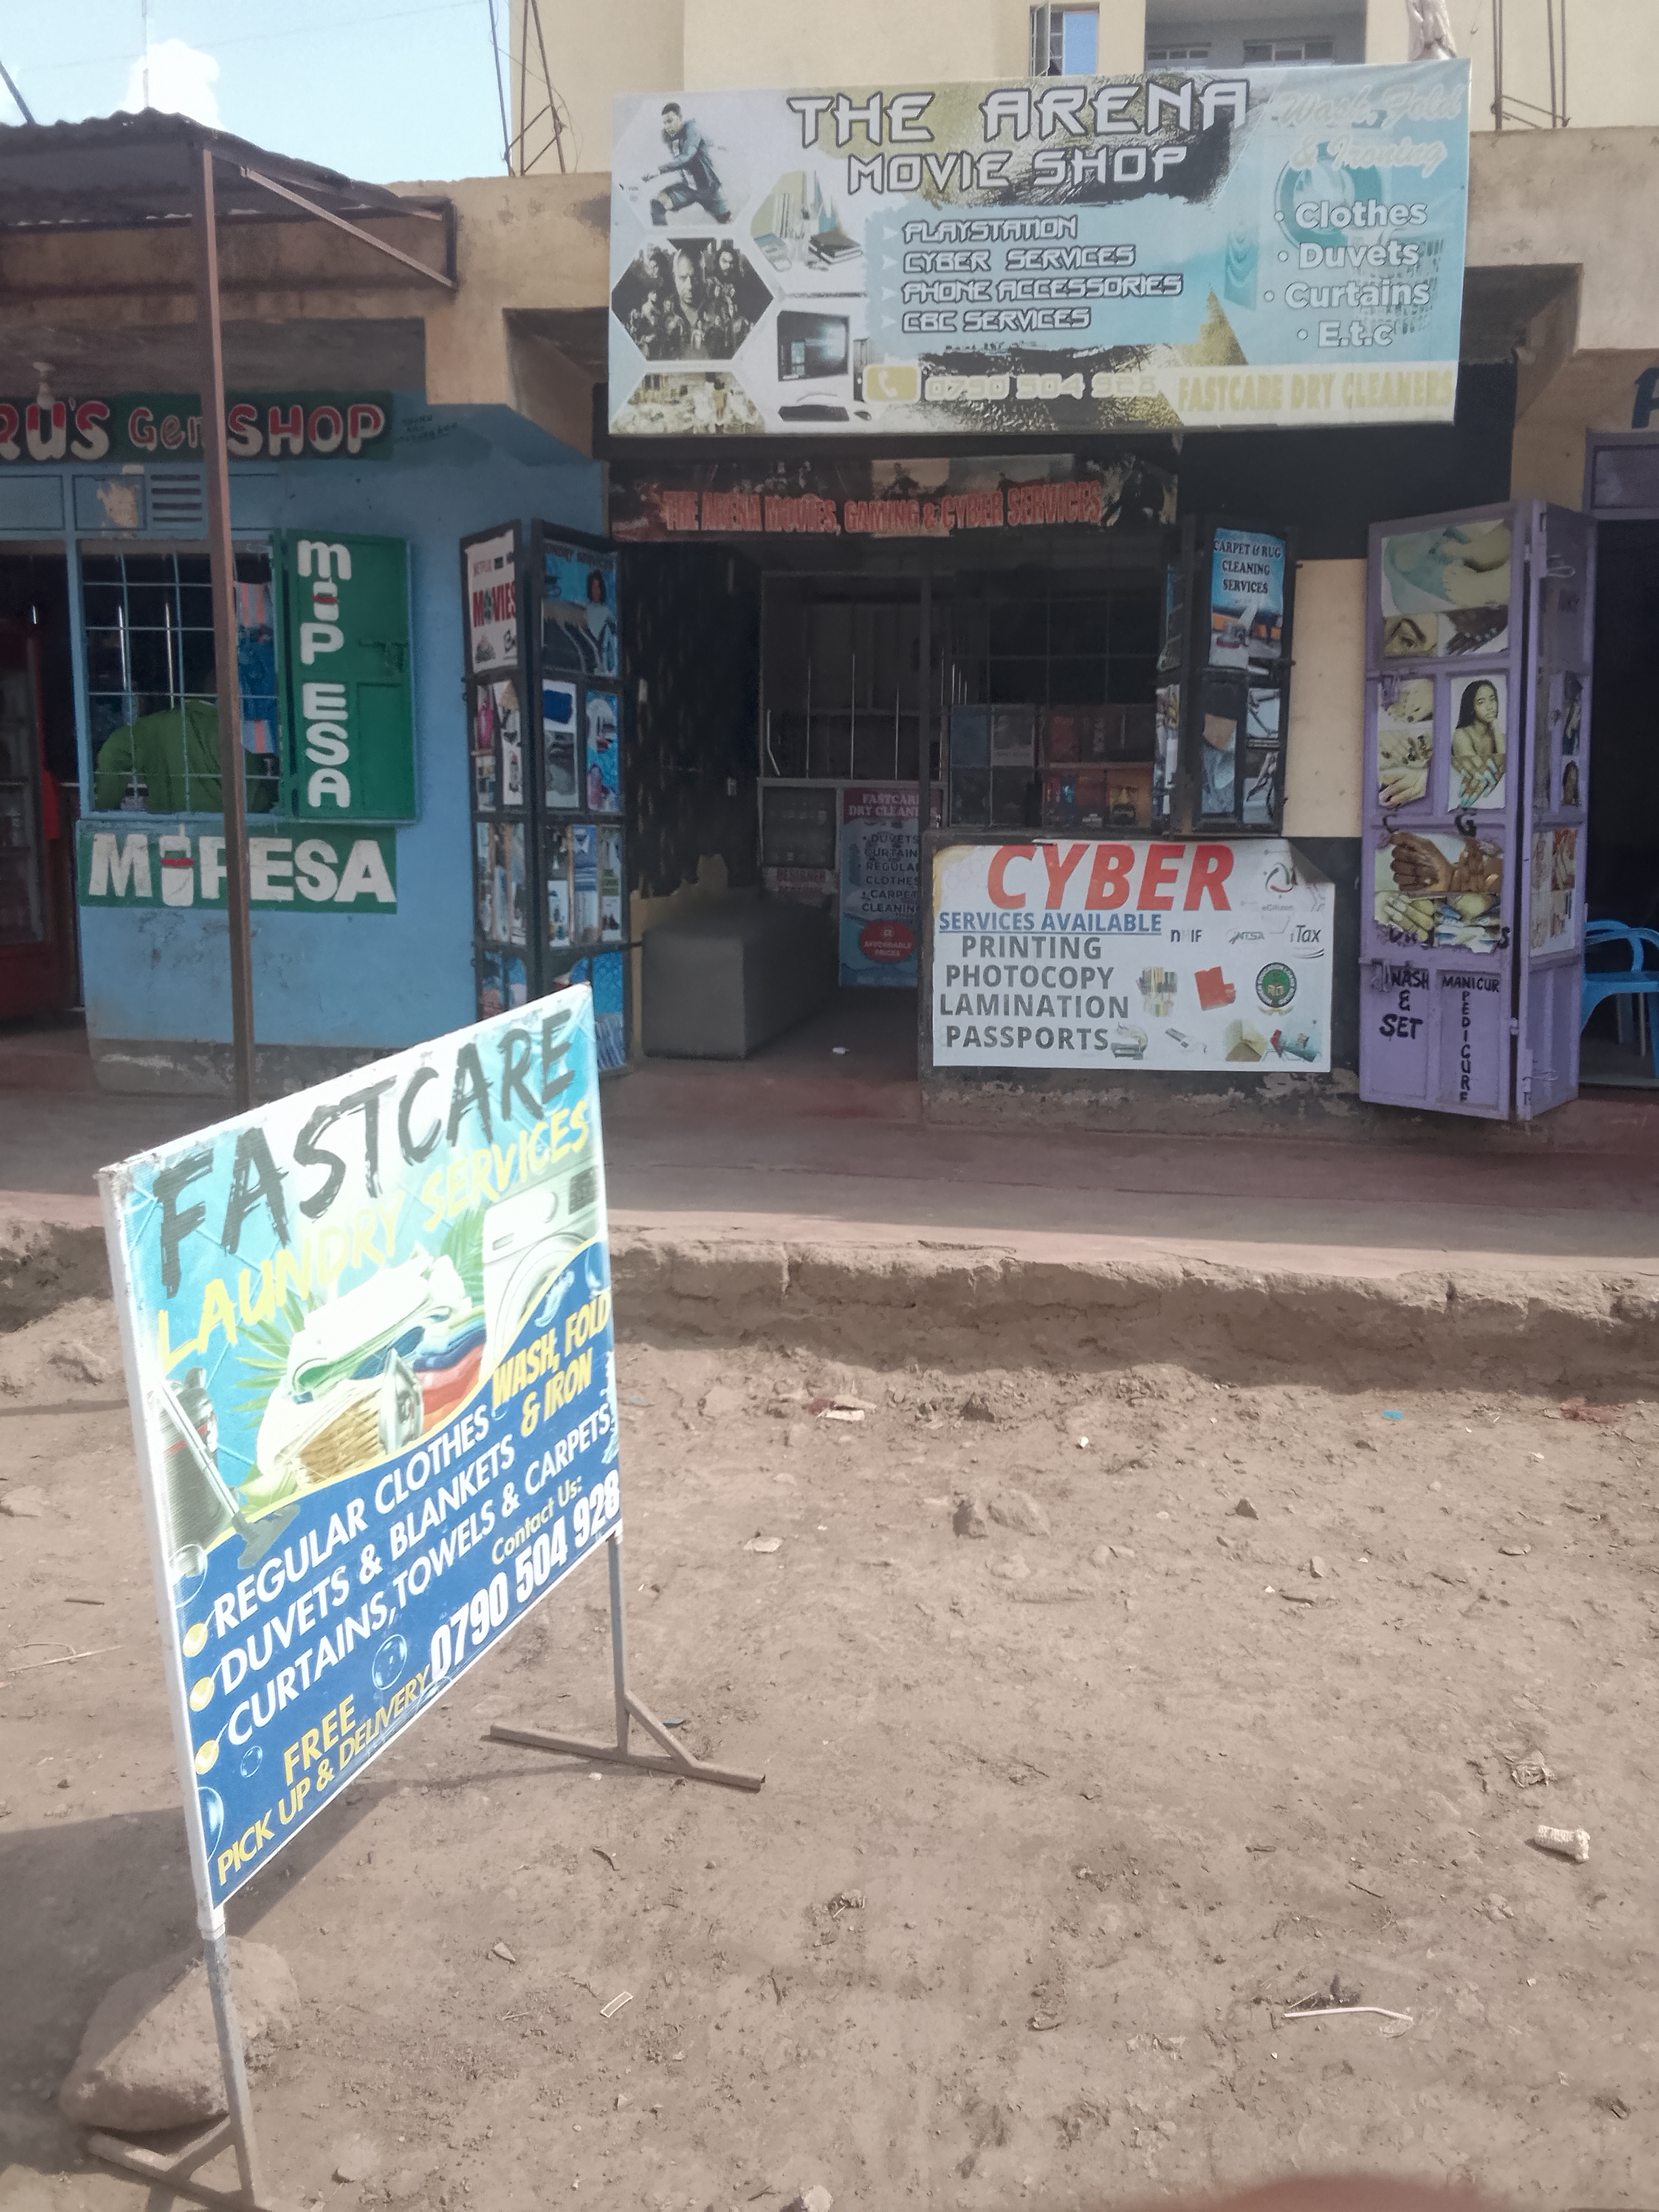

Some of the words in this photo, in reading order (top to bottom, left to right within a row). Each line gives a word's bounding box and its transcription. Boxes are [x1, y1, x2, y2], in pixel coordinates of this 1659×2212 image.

[786, 91, 936, 148] THE
[979, 77, 1250, 142] ARENA
[847, 150, 1014, 195] MOVIE
[1033, 145, 1188, 186] SHOP
[903, 215, 1078, 244] PLAYSTATION
[1294, 199, 1428, 229] Clothes
[903, 249, 991, 273] CYBER
[1005, 245, 1136, 271] SERVICES
[1299, 240, 1420, 269] Duvets
[901, 279, 992, 304] PHONE
[996, 272, 1184, 302] ACCESSORIES
[1284, 280, 1430, 308] Curtains
[902, 310, 958, 333] CBC
[963, 307, 1092, 332] SERVICES
[1317, 319, 1394, 348] E.t.c
[1016, 373, 1086, 400] 504
[1179, 374, 1284, 411] FASTCARE
[1291, 372, 1336, 409] DRY
[1342, 369, 1453, 409] CLEANERS
[228, 403, 386, 457] SHOP
[663, 491, 699, 531] THE
[701, 492, 763, 531] ARENA
[844, 499, 920, 533] GAMING
[922, 502, 938, 529] &
[941, 491, 1003, 529] CYBER
[1008, 480, 1103, 525] SERVICES
[1214, 539, 1250, 554] CARPET
[1252, 544, 1260, 556] &
[1262, 546, 1281, 558] RUG
[1222, 560, 1270, 575] CLEANING
[1223, 579, 1268, 594] SERVICES
[863, 848, 918, 859] CURTAIN
[987, 843, 1235, 911] CYBER
[939, 912, 1035, 932] SERVICES
[1041, 912, 1162, 933] AVAILABLE
[1290, 924, 1322, 943] iTax
[962, 936, 1102, 960] PRINTING
[945, 964, 1115, 989] PHOTOCOPY
[940, 993, 1129, 1019] LAMINATION
[945, 1025, 1109, 1051] PASSPORTS
[1379, 1014, 1423, 1040] SET
[152, 1009, 576, 1299] FASTCARE
[422, 1100, 589, 1232] SERVICES
[158, 1189, 406, 1372] LAUNDRY
[491, 1327, 560, 1410] WASH,
[565, 1289, 611, 1357] FOLD
[520, 1391, 541, 1437] &
[544, 1347, 592, 1421] IRON
[501, 1486, 520, 1519] &
[524, 1402, 610, 1496] CARPETS
[213, 1498, 368, 1640] REGULAR
[374, 1405, 489, 1515] CLOTHES
[492, 1498, 554, 1565] Contact
[220, 1565, 350, 1696] DUVETS
[359, 1542, 384, 1584] &
[389, 1433, 515, 1561] BLANKETS
[430, 1572, 510, 1682] 0790
[517, 1519, 569, 1605] 504
[574, 1470, 620, 1554] 928
[283, 1693, 357, 1786] FREE
[217, 1809, 275, 1886] PICK
[278, 1776, 310, 1826] UP
[316, 1757, 335, 1792] &
[338, 1662, 432, 1771] DELIVERY
